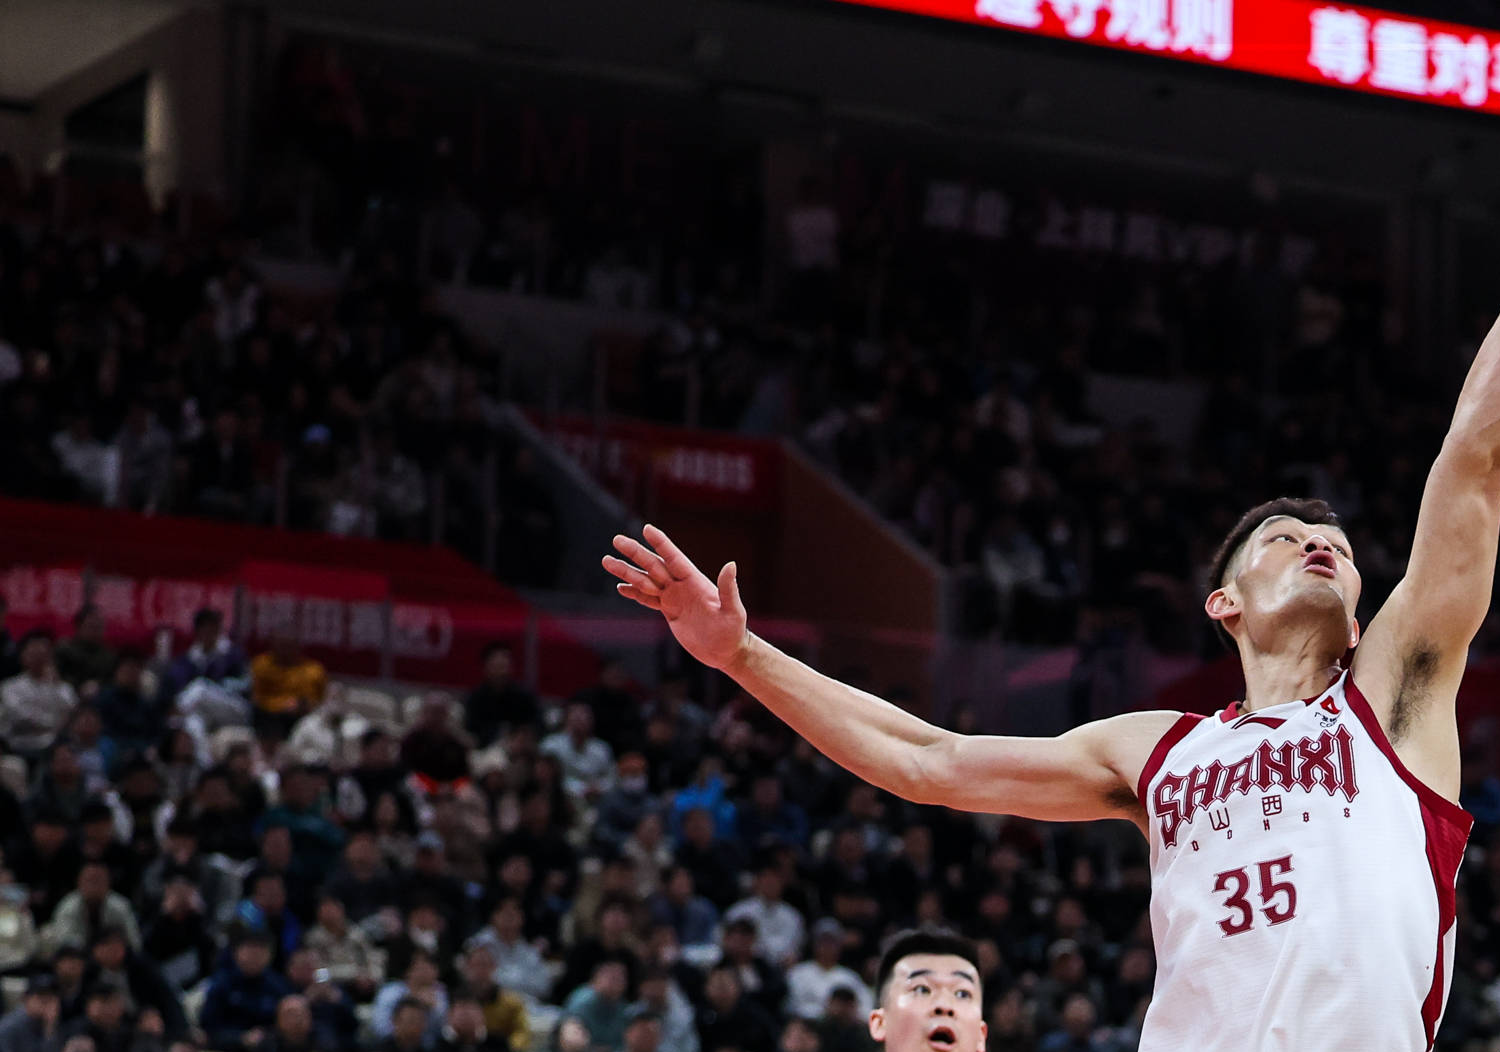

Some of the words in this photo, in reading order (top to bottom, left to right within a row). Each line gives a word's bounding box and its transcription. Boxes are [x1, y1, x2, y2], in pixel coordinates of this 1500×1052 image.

[1152, 723, 1360, 850] SHANXI
[1208, 795, 1283, 832] 山西
[1211, 854, 1298, 938] 35
